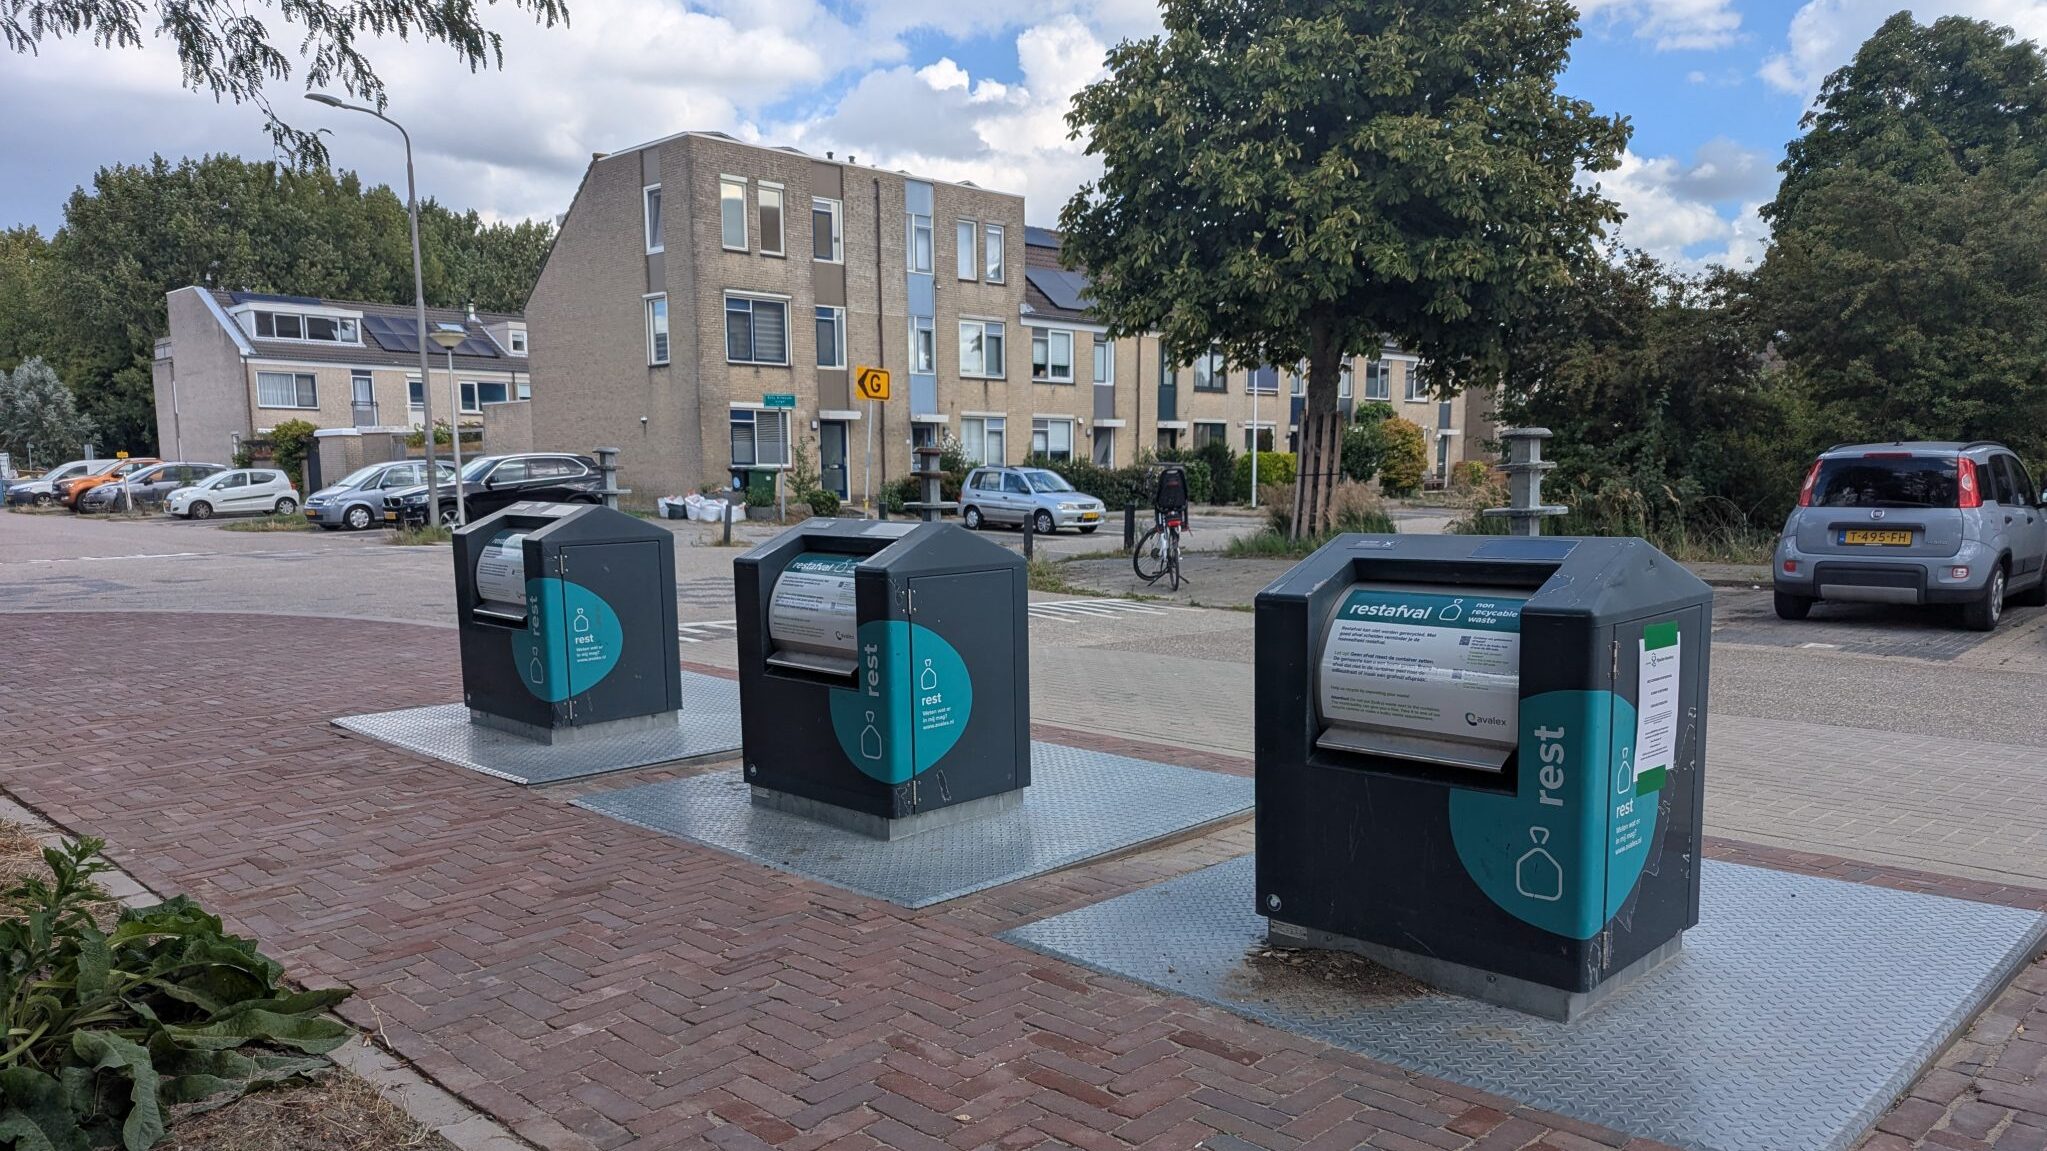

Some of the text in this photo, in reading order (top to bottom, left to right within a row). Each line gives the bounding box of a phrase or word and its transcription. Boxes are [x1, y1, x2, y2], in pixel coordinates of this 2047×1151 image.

[870, 374, 881, 393] G
[1849, 532, 1907, 543] T-495-FH
[792, 562, 835, 572] restafval
[530, 596, 540, 636] rest
[1349, 604, 1433, 619] restafval
[575, 634, 594, 644] rest
[864, 644, 880, 696] rest
[922, 692, 942, 706] rest
[1476, 716, 1506, 726] avalex
[1534, 726, 1565, 807] rest
[1616, 798, 1634, 819] rest
